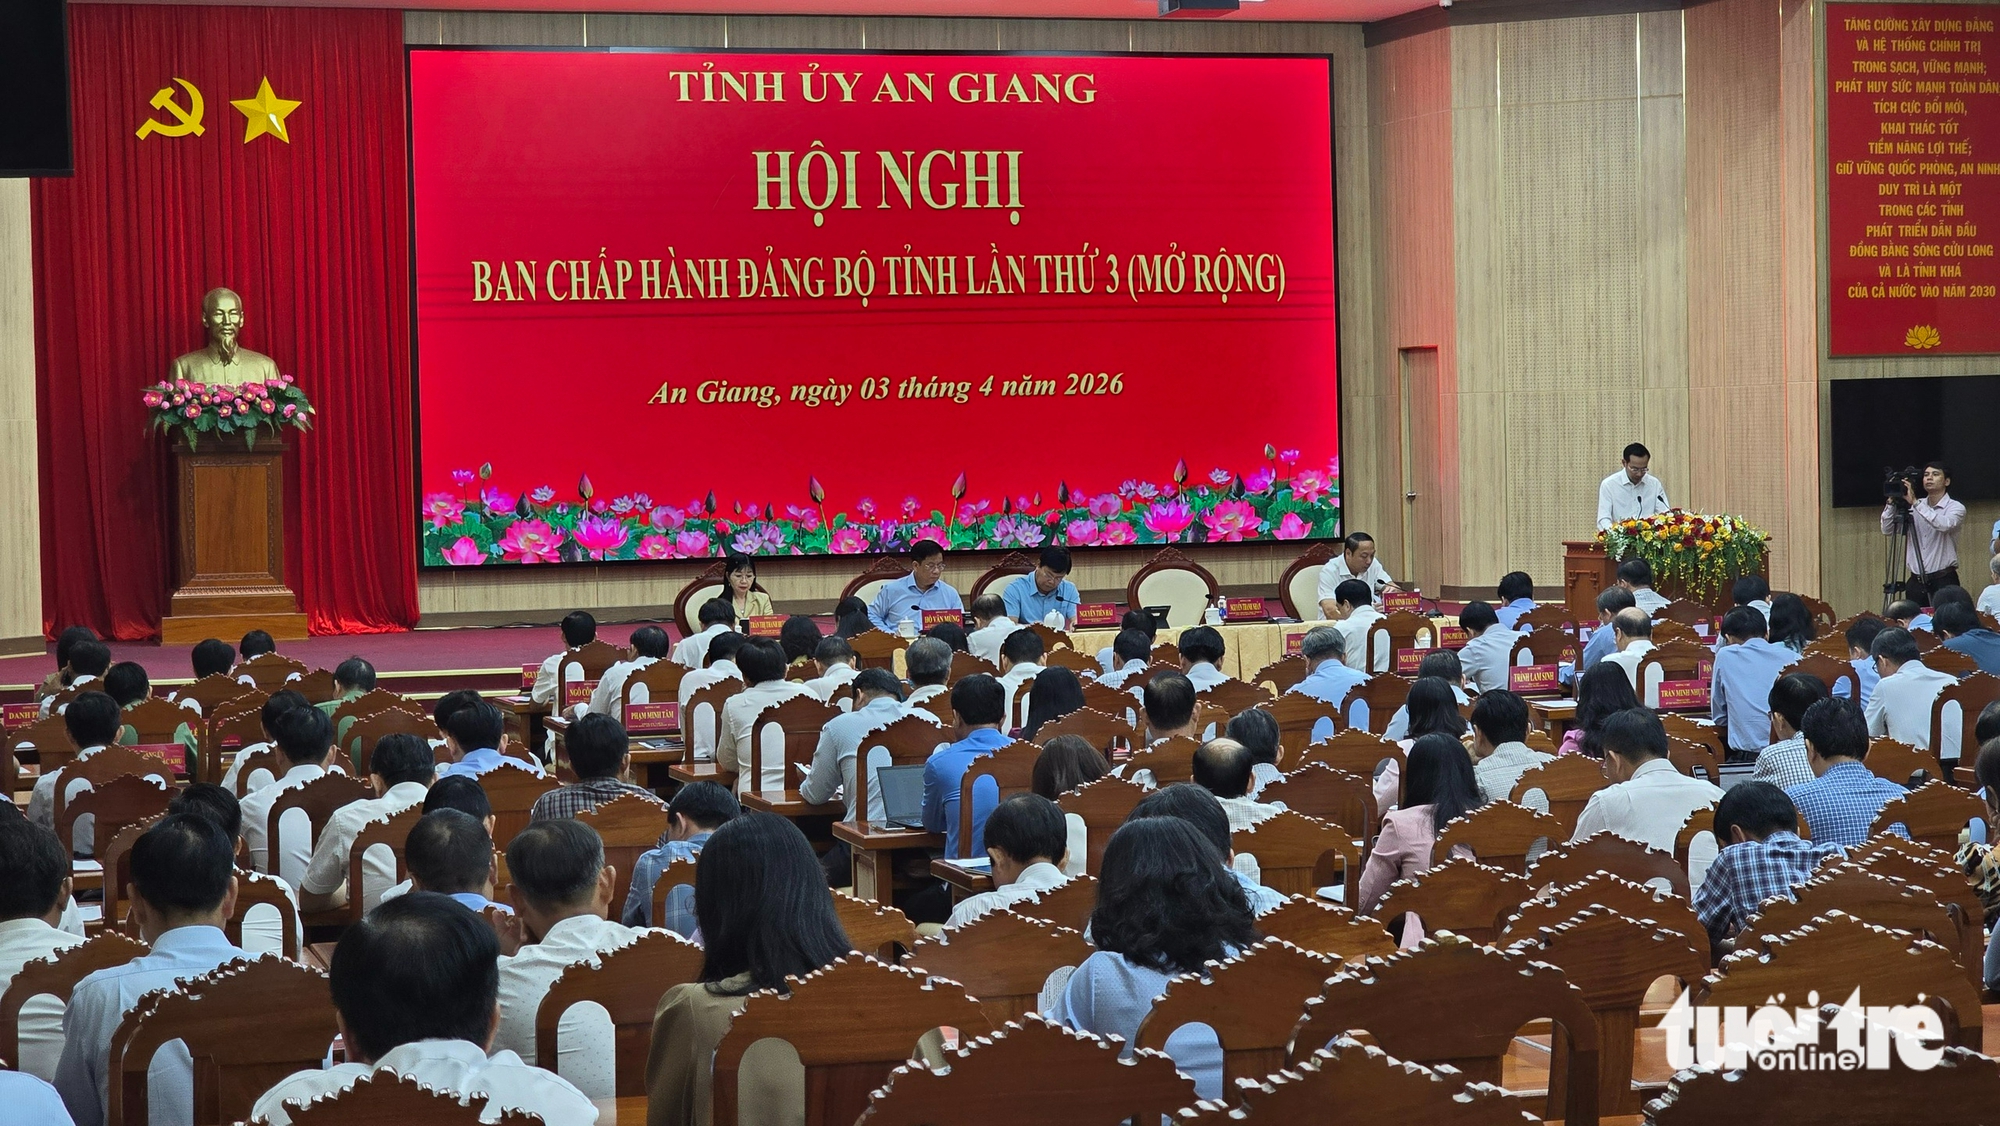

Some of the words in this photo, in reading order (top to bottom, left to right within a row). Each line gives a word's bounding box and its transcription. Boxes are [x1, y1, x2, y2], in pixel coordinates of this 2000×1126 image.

[1844, 17, 1870, 31] TĂNG
[1874, 17, 1908, 31] CƯỜNG
[1912, 18, 1931, 31] XÂY
[1934, 20, 1962, 34] DỰNG
[1966, 17, 1994, 32] ĐẢNG
[1856, 38, 1868, 51] VÀ
[1874, 37, 1886, 54] HỆ
[1891, 35, 1926, 51] THỐNG
[1930, 38, 1960, 52] CHÍNH
[1964, 41, 1981, 55] TRỊ
[1853, 61, 1886, 73] TRONG
[1890, 61, 1919, 75] SẠCH,
[1923, 59, 1951, 73] VỮNG
[1954, 62, 1987, 75] MẠNH;
[669, 62, 786, 102] TỈNH
[799, 63, 863, 103] ỦY
[872, 73, 935, 103] AN
[948, 73, 1097, 104] GIANG
[1836, 78, 1862, 92] PHÁT
[1867, 81, 1887, 92] HUY
[1892, 79, 1912, 92] SỨC
[1916, 82, 1945, 95] MẠNH
[1949, 79, 1976, 93] TOÀN
[1873, 99, 1897, 113] TÍCH
[1901, 100, 1920, 116] CỰC
[1925, 95, 1942, 113] ĐỔI
[1945, 99, 1967, 116] MỚI,
[1881, 123, 1905, 134] KHAI
[1909, 119, 1935, 134] THÁC
[1939, 118, 1959, 134] TỐT
[1868, 137, 1893, 154] TIỀM
[1897, 140, 1924, 154] NĂNG
[1928, 141, 1944, 157] LỢI
[1948, 138, 1972, 155] THẾ;
[1836, 160, 1853, 174] GIỮ
[1857, 160, 1884, 174] VỮNG
[1888, 159, 1916, 176] QUỐC
[1920, 161, 1957, 176] PHÒNG,
[1960, 163, 1973, 174] AN
[752, 140, 862, 227] HỘI
[875, 149, 1025, 225] NGHỊ
[1879, 184, 1899, 195] DUY
[1904, 181, 1920, 195] TRÌ
[1923, 181, 1936, 195] LÀ
[1940, 181, 1962, 198] MỘT
[1879, 205, 1913, 216] TRONG
[1917, 201, 1936, 216] CÁC
[1941, 200, 1964, 216] TỈNH
[1866, 222, 1893, 237] PHÁT
[1898, 219, 1927, 237] TRIỂN
[1932, 220, 1951, 236] DẪN
[1956, 221, 1976, 236] ĐẦU
[1850, 241, 1878, 257] ĐỒNG
[1881, 240, 1909, 257] BẰNG
[1913, 243, 1940, 256] SÔNG
[1943, 241, 1964, 256] CỬU
[1968, 245, 1993, 256] LONG
[472, 260, 536, 302] BAN
[546, 247, 633, 301] CHẤP
[640, 246, 730, 299] HÀNH
[738, 245, 825, 298] ĐẢNG
[834, 250, 875, 307] BỘ
[882, 244, 958, 295] TỈNH
[966, 244, 1026, 294] LẦN
[1034, 243, 1100, 294] THỨ
[1105, 255, 1120, 293] 3
[1127, 242, 1186, 302] (MỞ
[1193, 248, 1285, 303] RỘNG)
[1879, 263, 1891, 277] VÀ
[1897, 263, 1910, 277] LÀ
[1913, 262, 1936, 277] TỈNH
[1940, 262, 1961, 277] KHÁ
[1848, 282, 1868, 298] CỦA
[1871, 282, 1885, 298] CẢ
[1889, 284, 1916, 298] NƯỚC
[1920, 284, 1939, 297] VÀO
[1943, 283, 1965, 297] NĂM
[1970, 286, 1996, 297] 2030
[648, 382, 687, 405] An
[696, 380, 781, 408] Giang,
[790, 378, 852, 407] ngày
[860, 377, 890, 400] 03
[898, 375, 972, 403] tháng
[979, 375, 994, 397] 4
[1001, 375, 1056, 396] năm
[1064, 372, 1124, 396] 2026
[1542, 671, 1554, 681] SINH
[631, 712, 647, 721] PHẠM
[647, 711, 662, 719] MINH
